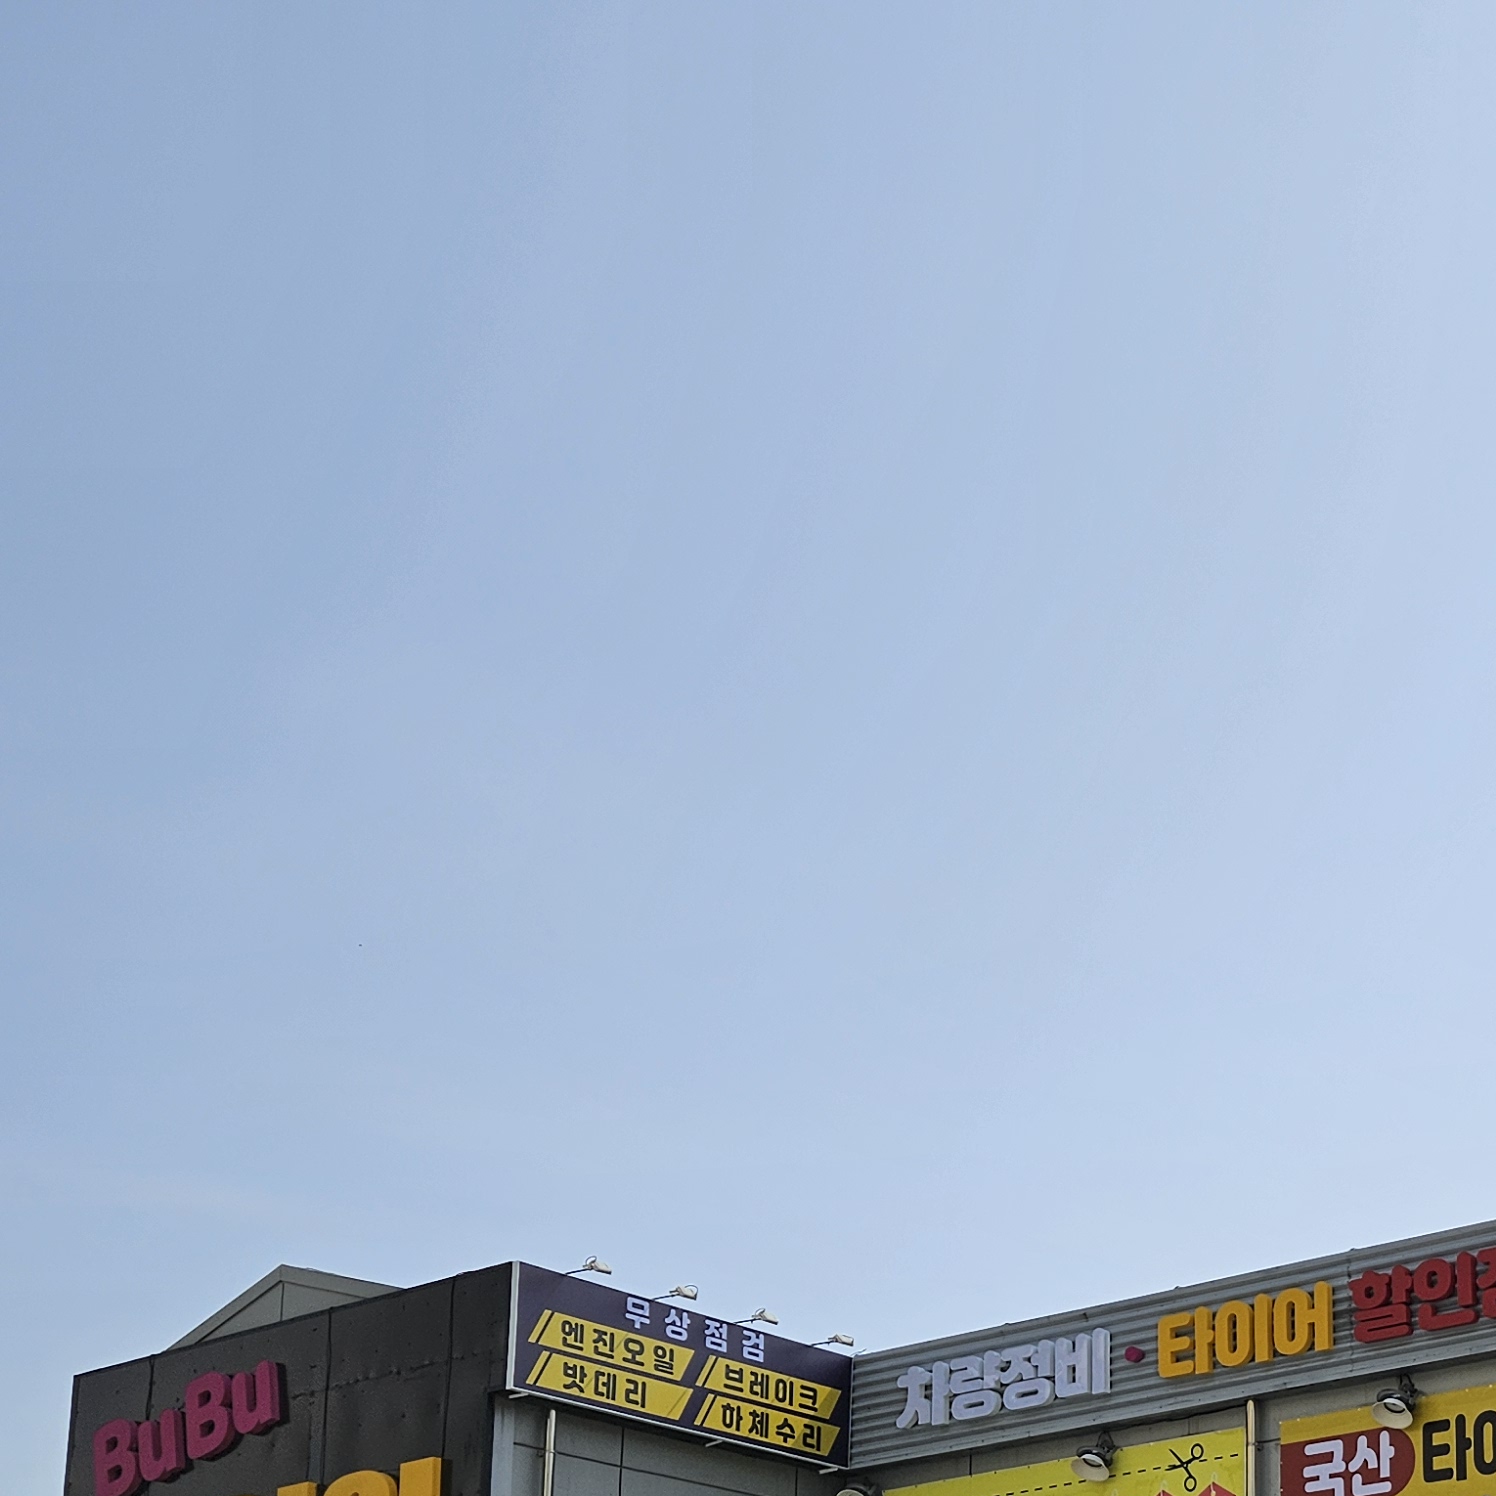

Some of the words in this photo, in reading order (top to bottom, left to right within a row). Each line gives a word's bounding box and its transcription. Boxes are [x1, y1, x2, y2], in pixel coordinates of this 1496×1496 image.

[560, 1319, 675, 1374] 엔진오일
[896, 1328, 1111, 1429] 차량정비
[1157, 1281, 1334, 1378] 타이어
[562, 1361, 647, 1409] 밧데리
[723, 1364, 819, 1413] 브레이크
[721, 1402, 822, 1452] 하체수리
